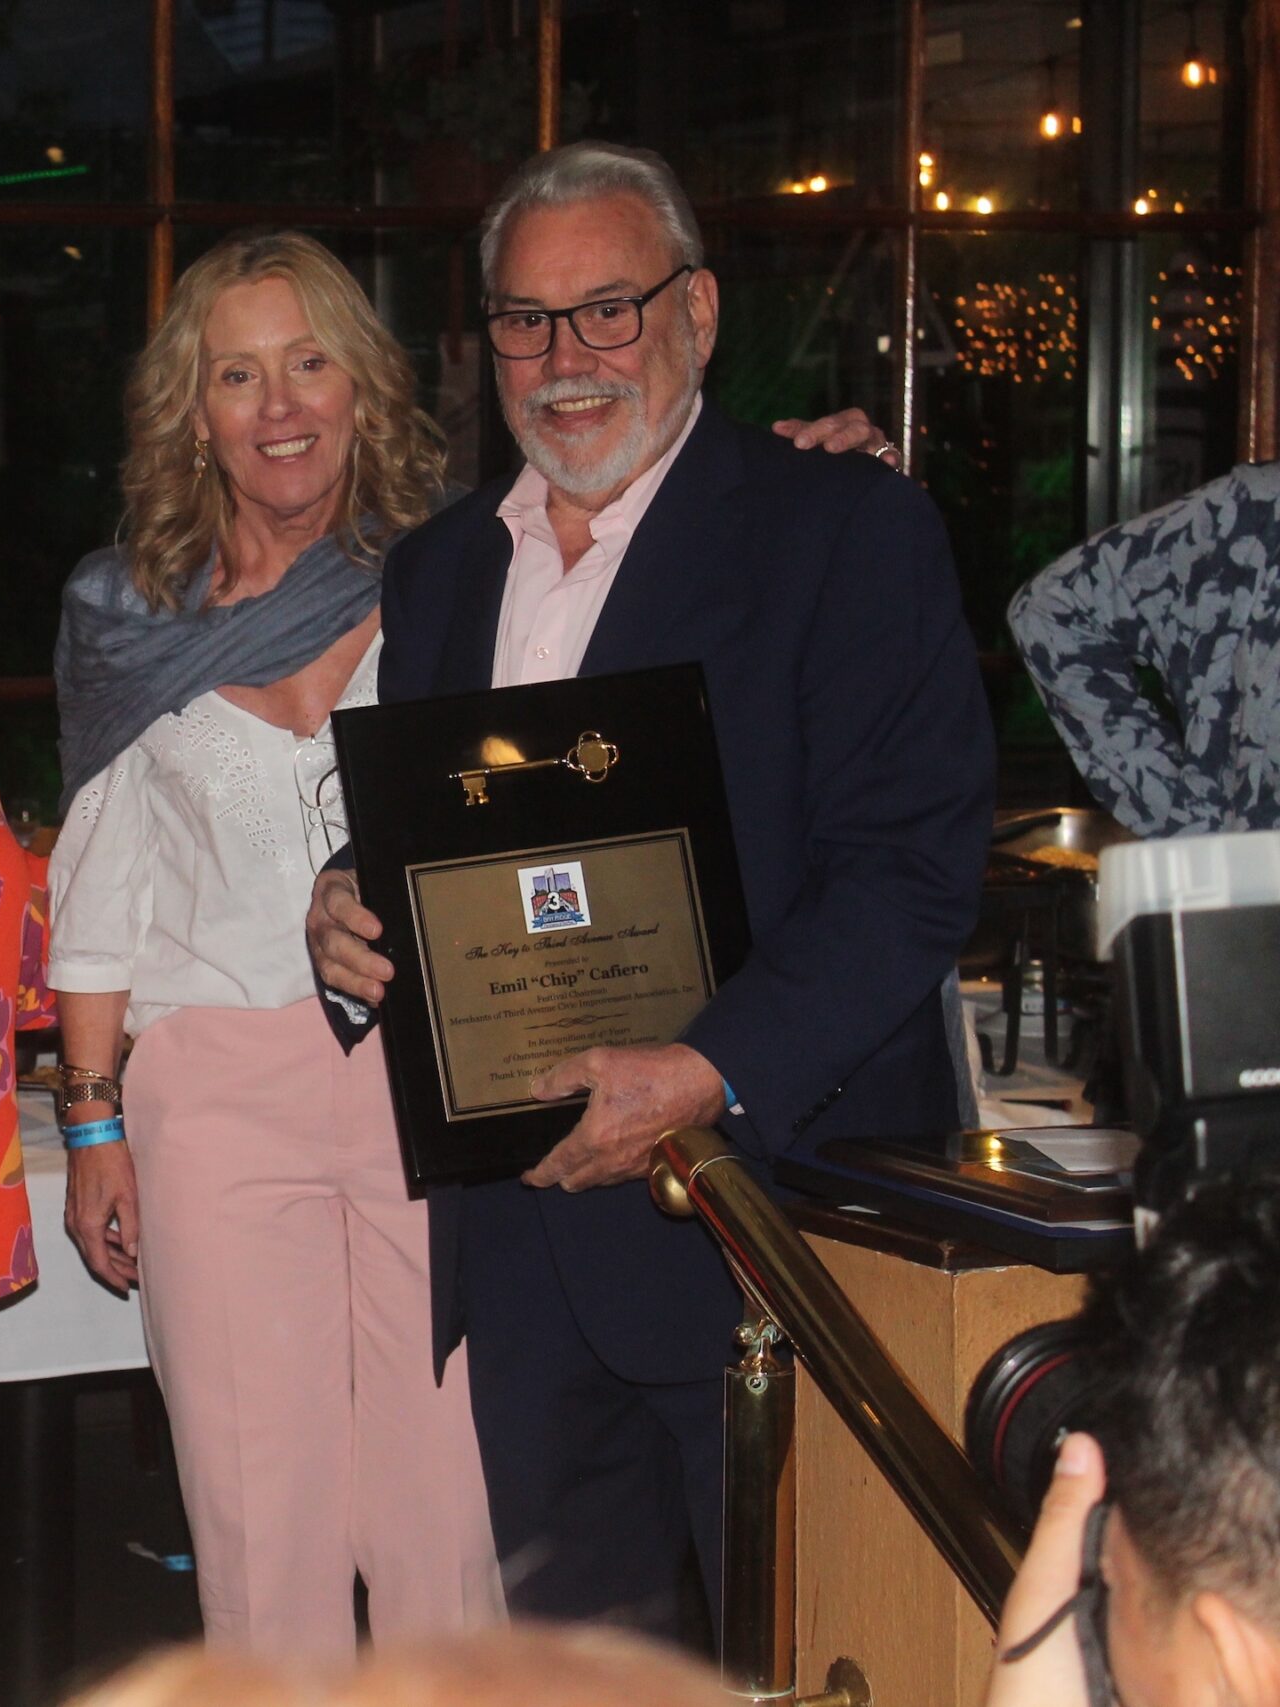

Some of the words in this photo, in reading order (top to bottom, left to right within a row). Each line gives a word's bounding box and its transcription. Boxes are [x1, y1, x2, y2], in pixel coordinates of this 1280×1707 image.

[548, 892, 560, 910] 3
[465, 946, 488, 960] The
[491, 942, 519, 959] Key
[521, 943, 530, 952] to
[534, 936, 568, 951] Third
[570, 931, 613, 946] Avenue
[617, 922, 659, 939] Award
[489, 978, 528, 995] Emil
[589, 964, 648, 981] Cafiero
[537, 991, 567, 1003] Festival
[449, 1014, 492, 1026] Merchants
[493, 1011, 502, 1020] of
[504, 1008, 525, 1019] Third
[527, 1005, 556, 1015] Avenue
[528, 1039, 537, 1048] In
[503, 1055, 512, 1064] of
[489, 1070, 515, 1081] Thank
[517, 1068, 533, 1078] You
